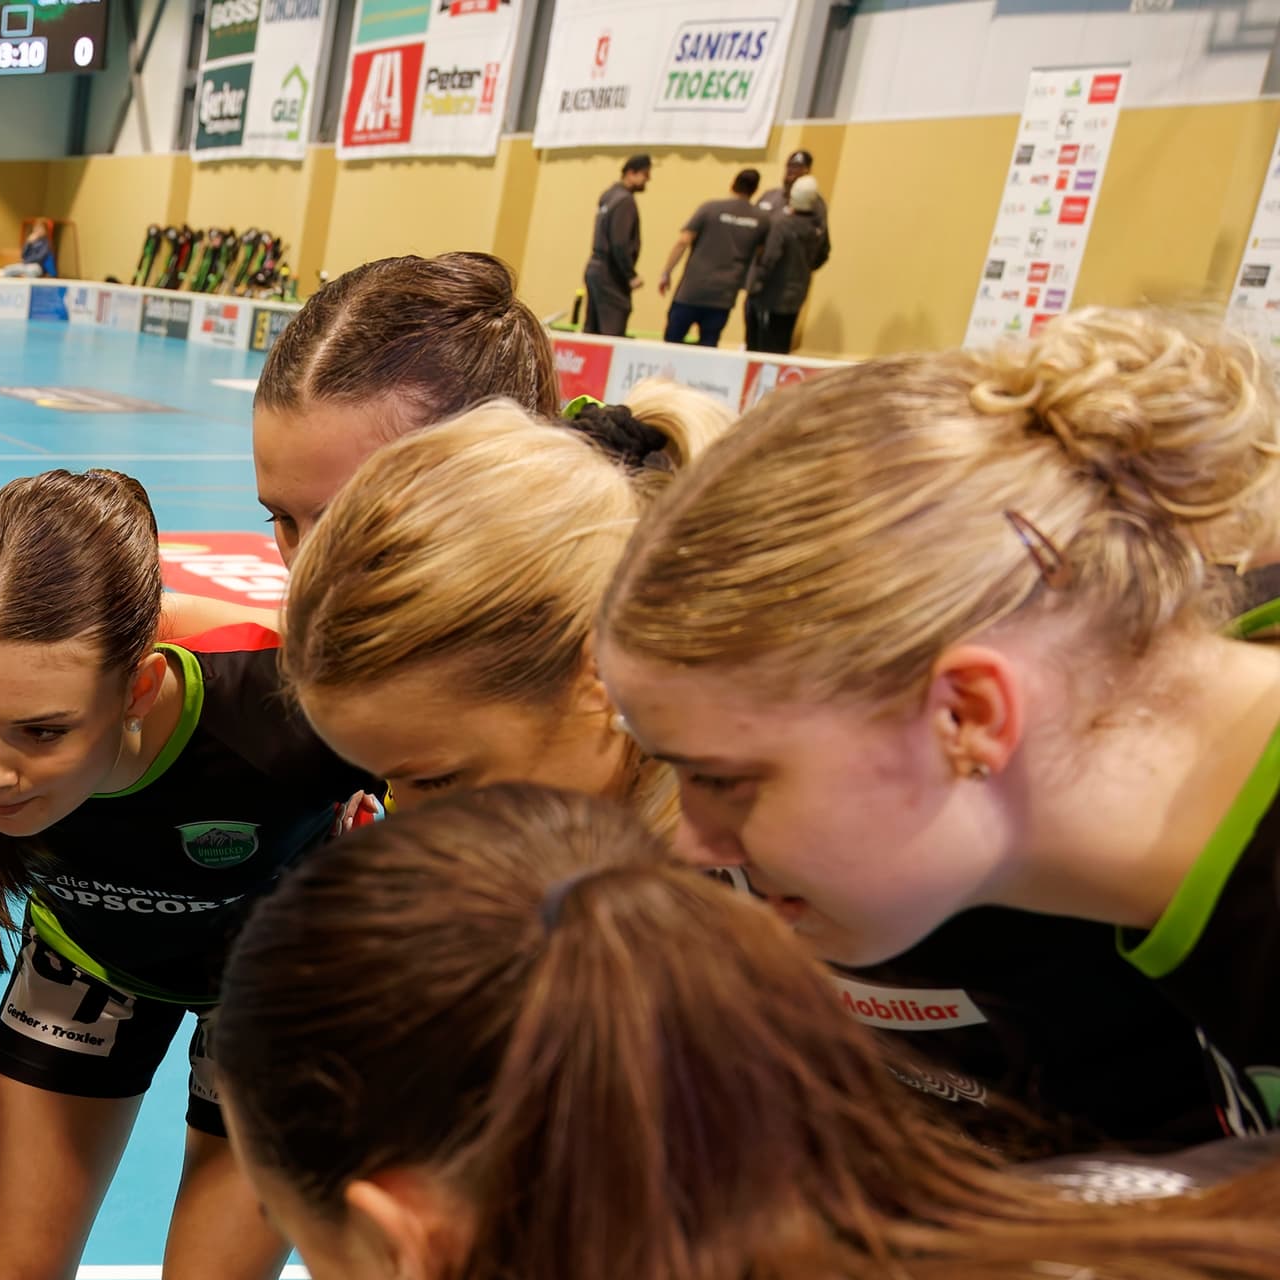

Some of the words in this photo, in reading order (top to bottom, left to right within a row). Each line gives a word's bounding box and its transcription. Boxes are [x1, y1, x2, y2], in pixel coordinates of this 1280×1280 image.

[675, 29, 768, 62] SANITAS
[664, 69, 754, 101] TROESCH
[56, 874, 89, 889] die
[92, 879, 197, 900] Mobiliar
[6, 1002, 41, 1031] Gerber
[51, 1023, 106, 1048] Troxler
